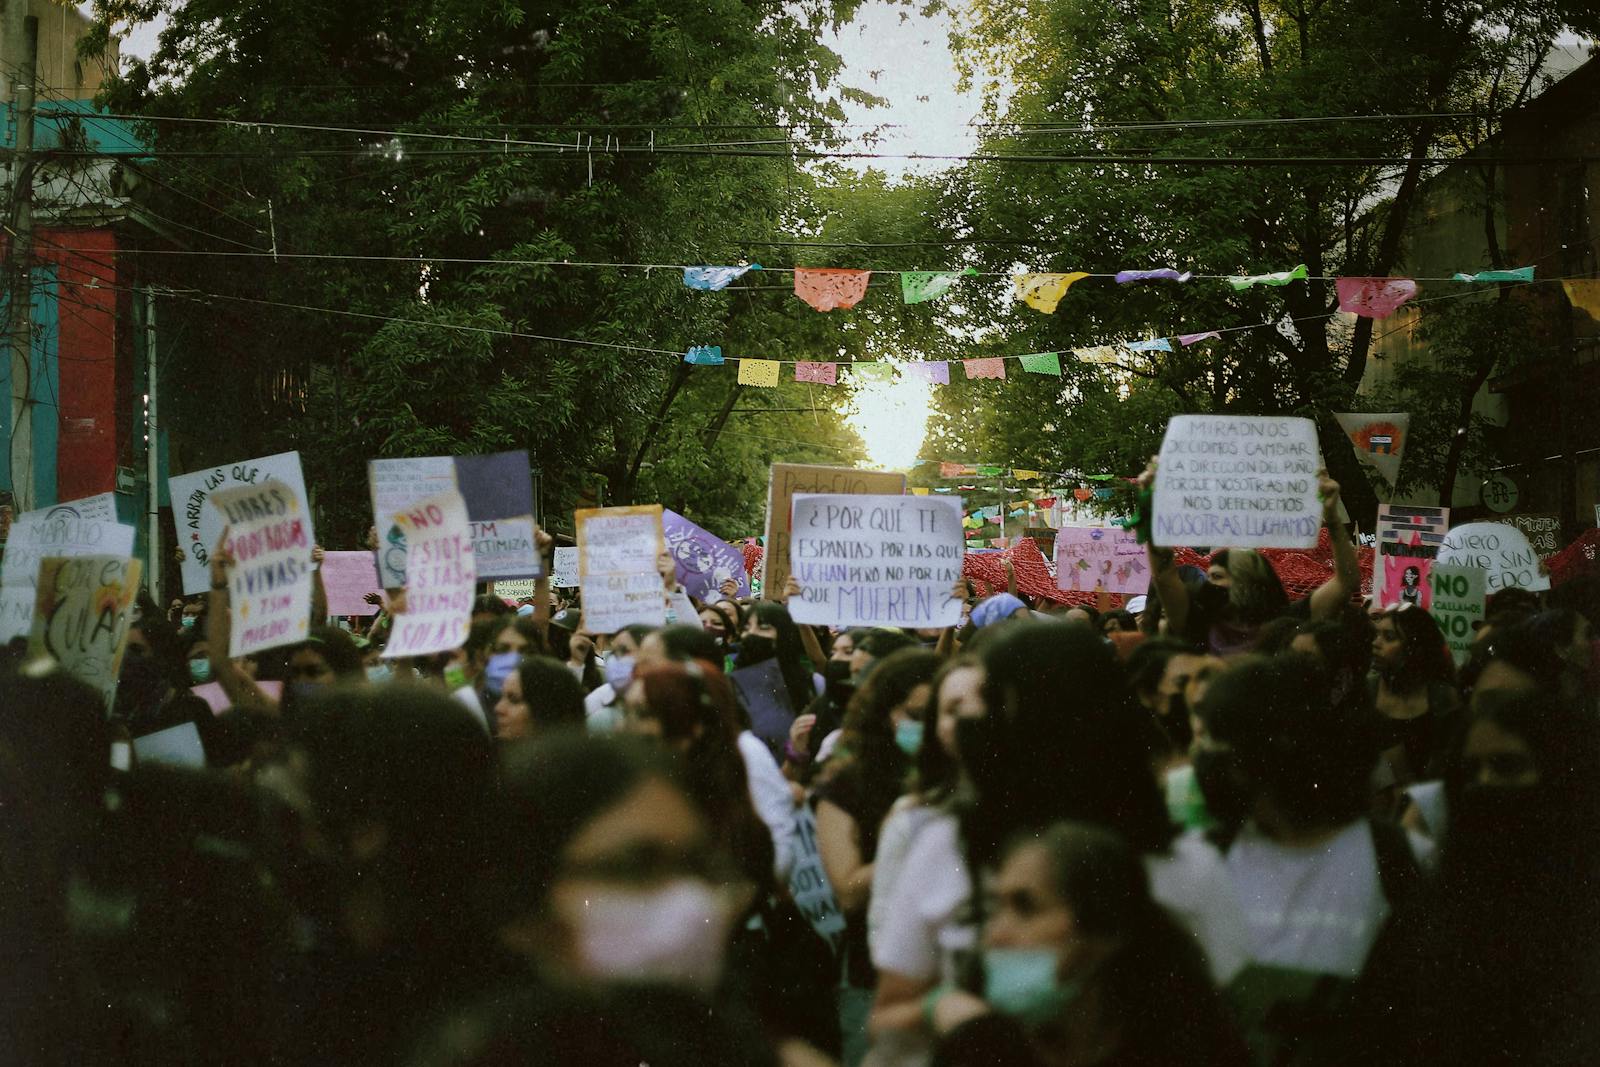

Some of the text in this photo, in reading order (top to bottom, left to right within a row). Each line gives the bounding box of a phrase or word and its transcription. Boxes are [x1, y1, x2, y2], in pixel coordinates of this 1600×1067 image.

[1167, 440, 1312, 456] DECIDIMOS CAMBIAR
[1167, 460, 1184, 472] LA
[1260, 461, 1281, 473] DEL
[204, 469, 225, 490] LAS
[231, 465, 259, 485] QUE
[1215, 477, 1283, 493] NOSOTRAS
[1288, 479, 1308, 493] NO
[1183, 495, 1304, 512] NOS DEFENDEMOS
[409, 505, 444, 528] NO
[809, 502, 939, 534] ¿POR QUÉ TE
[1157, 512, 1318, 537] NOSOTRAS LUCHAMOS
[798, 538, 874, 559] ESPANTAS
[880, 541, 904, 558] POR
[909, 543, 932, 558] LAS
[935, 544, 961, 559] QUE
[1500, 549, 1533, 569] SIN
[849, 567, 880, 583] PERO
[886, 566, 904, 581] NO
[909, 566, 932, 580] POR
[1434, 574, 1469, 598] NO
[800, 585, 830, 603] QUE
[837, 585, 932, 621] MUEREN
[1433, 601, 1482, 614] CALLAMOS
